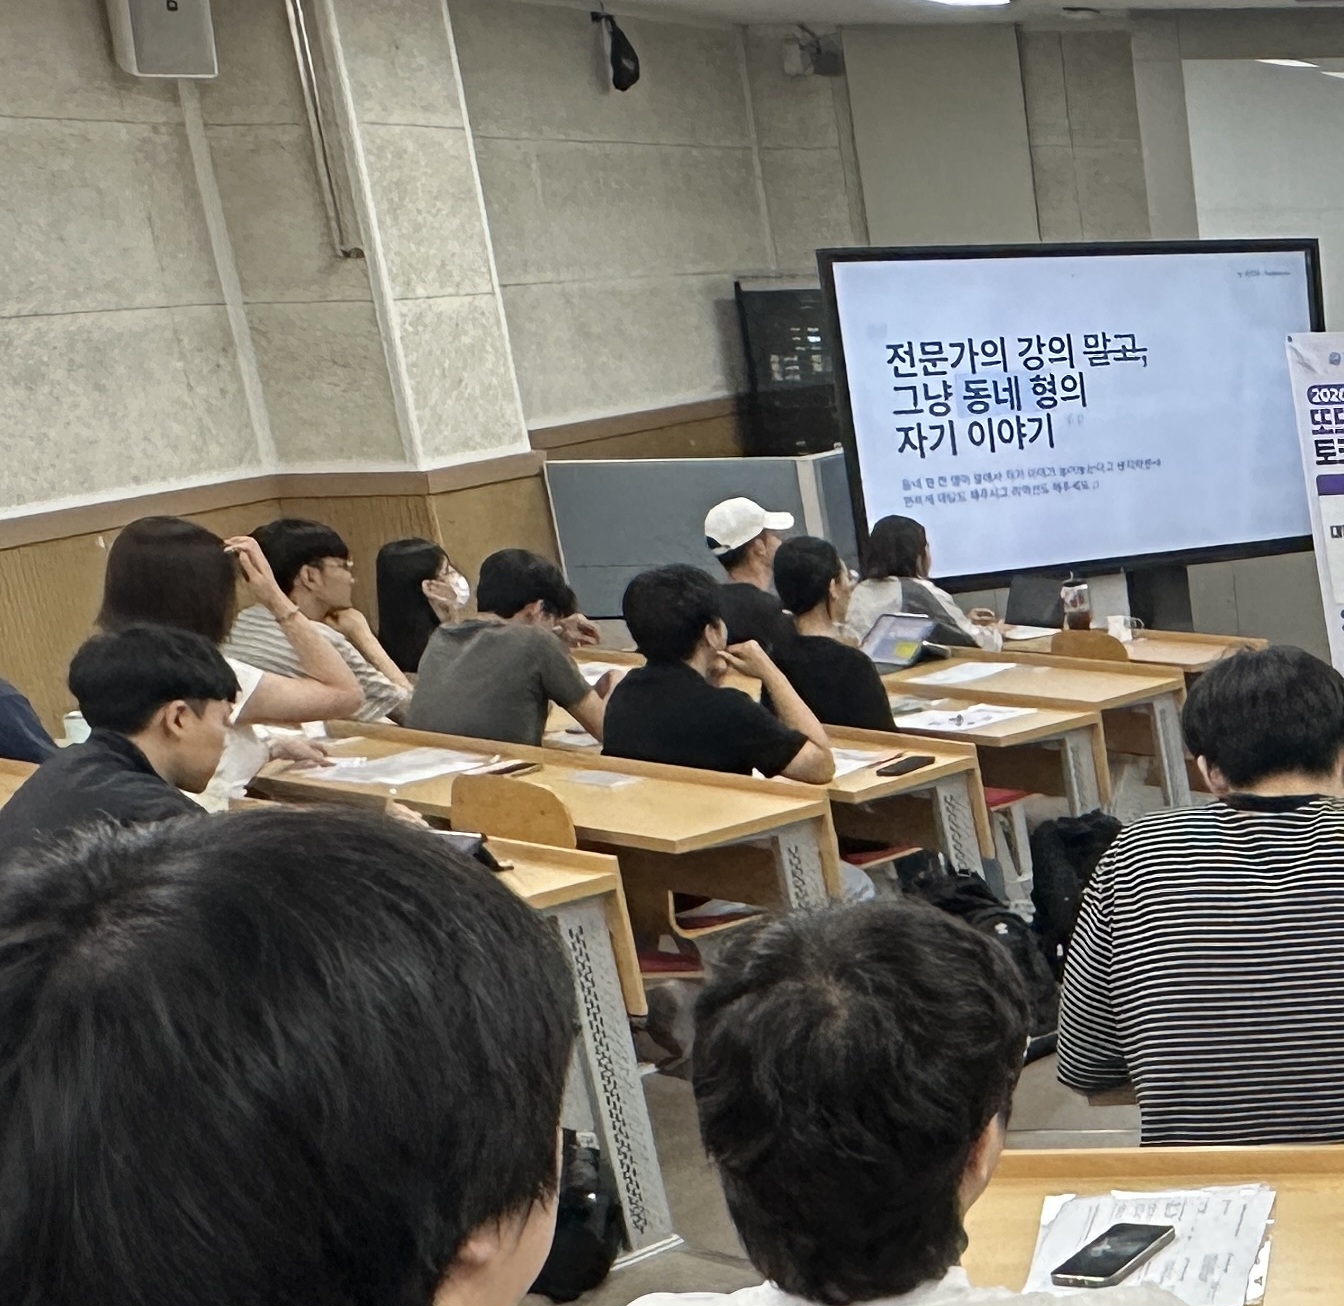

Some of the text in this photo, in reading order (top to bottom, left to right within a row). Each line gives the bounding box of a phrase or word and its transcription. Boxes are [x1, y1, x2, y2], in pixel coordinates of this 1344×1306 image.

[885, 331, 1149, 378] 전문가의 강의 말고,
[892, 371, 1088, 417] 그냥 동네 형의
[895, 412, 1055, 459] 자기 이야기
